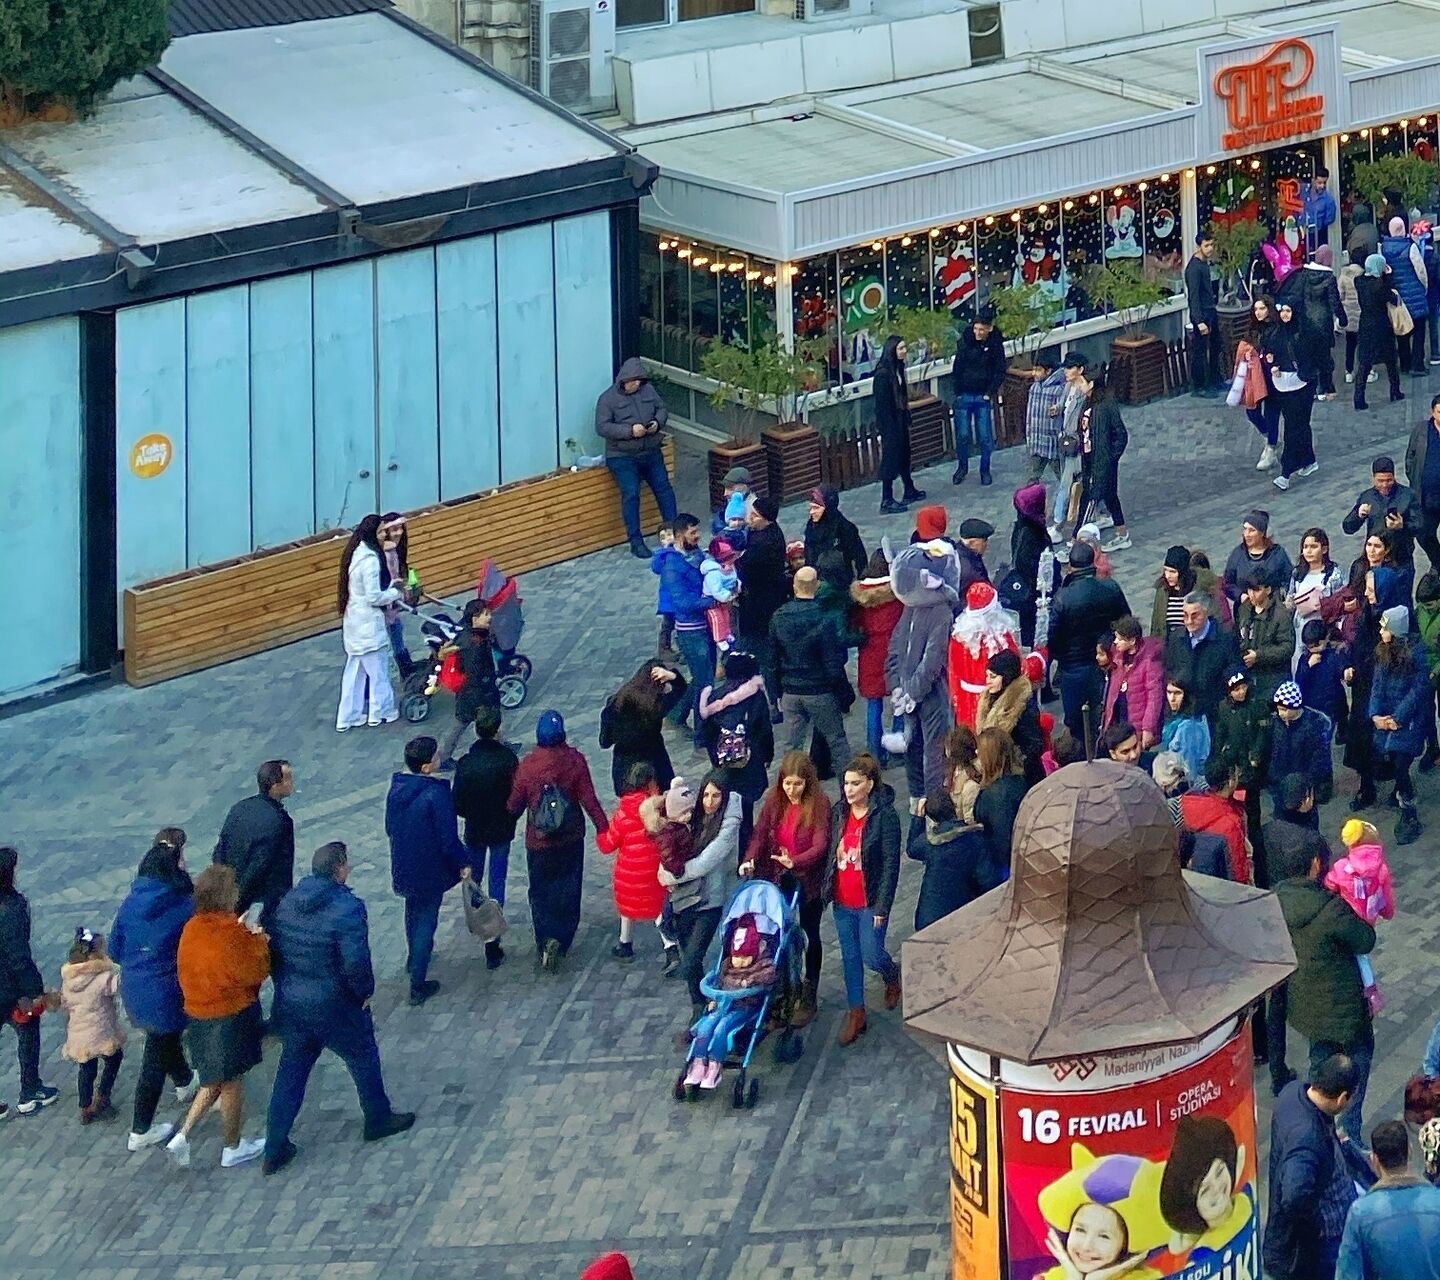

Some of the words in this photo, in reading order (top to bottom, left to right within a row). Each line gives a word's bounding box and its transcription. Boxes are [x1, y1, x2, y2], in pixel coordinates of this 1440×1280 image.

[1223, 114, 1324, 151] RESTAURANT
[1177, 1080, 1214, 1105] OPERA
[1018, 1107, 1061, 1145] 16
[1068, 1108, 1147, 1137] FEVRAL
